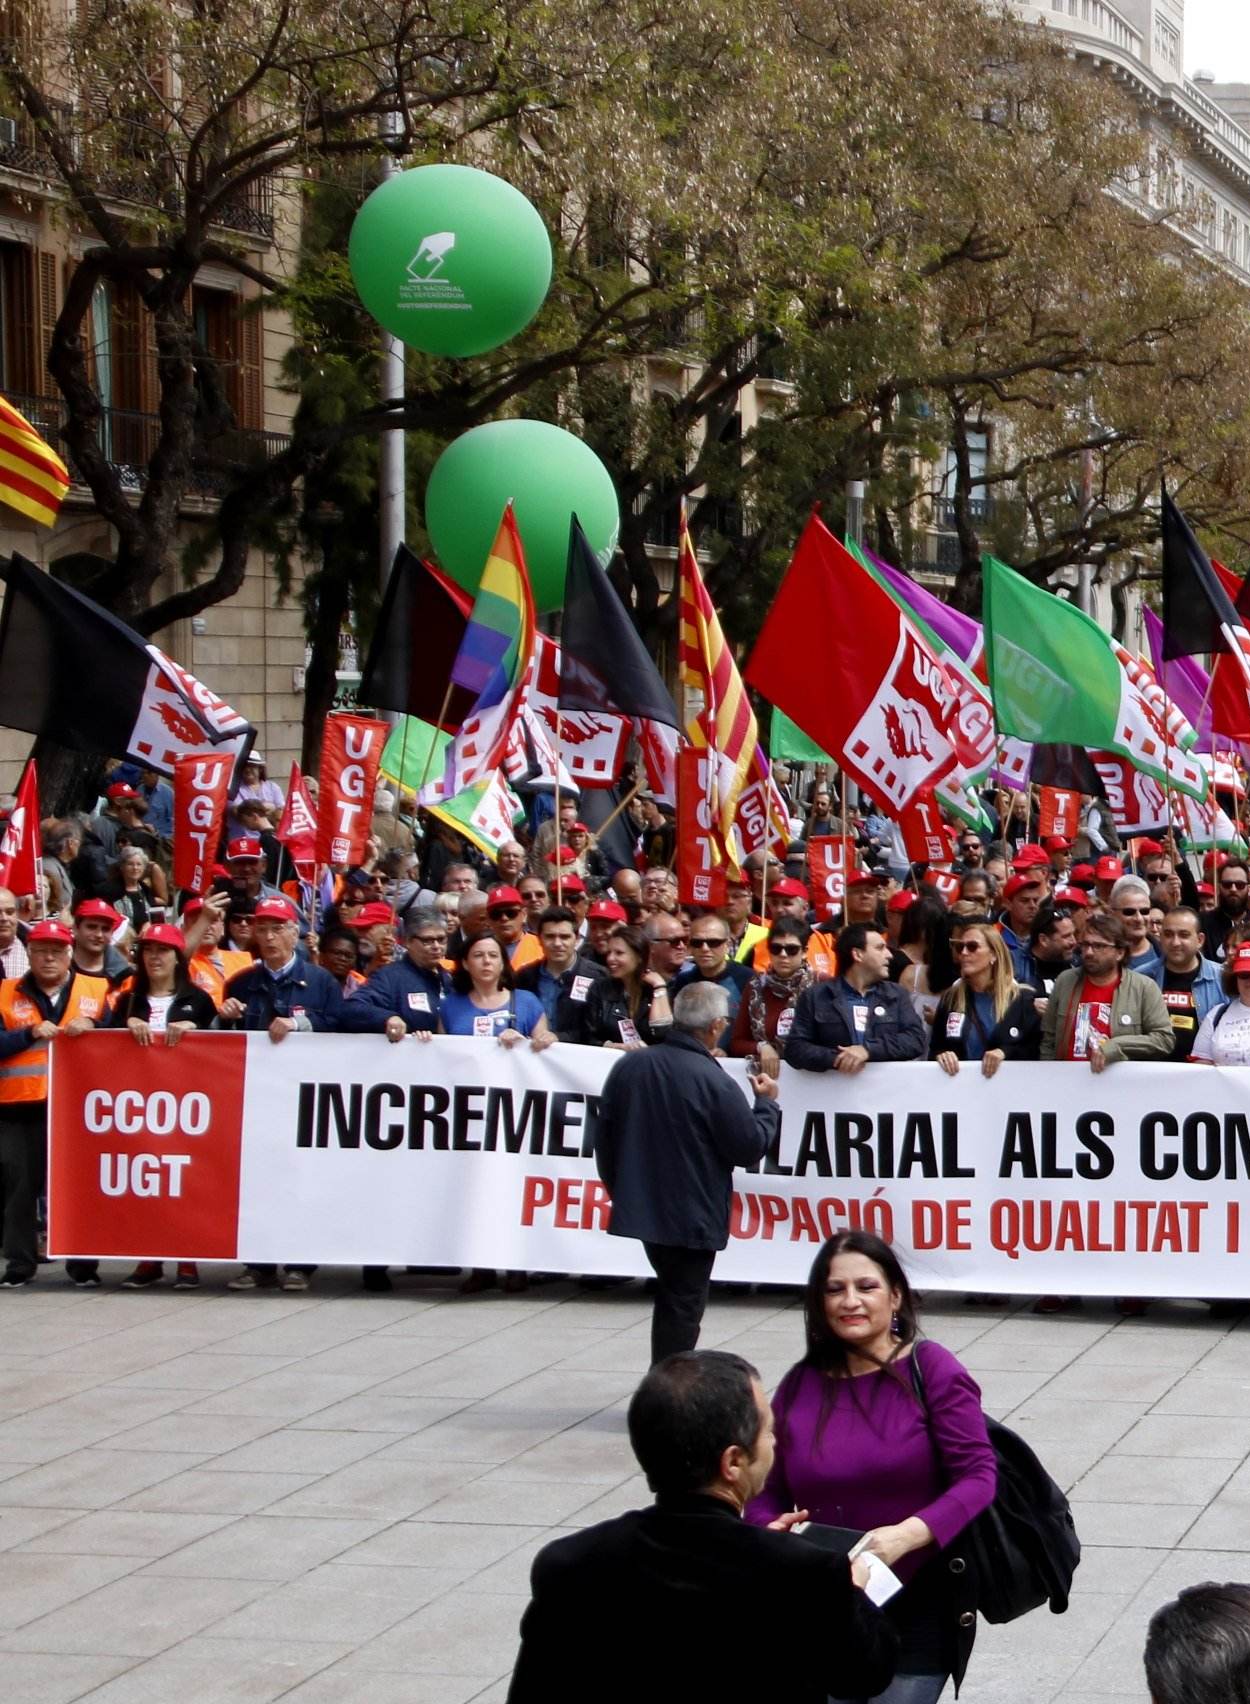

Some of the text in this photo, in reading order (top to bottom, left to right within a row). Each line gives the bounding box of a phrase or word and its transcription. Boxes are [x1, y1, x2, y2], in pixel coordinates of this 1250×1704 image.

[188, 761, 223, 862] UGT
[337, 726, 374, 833] UGT
[1162, 993, 1188, 1005] COO
[84, 1088, 212, 1136] CCOO
[297, 1081, 601, 1159] INCREME
[744, 1109, 975, 1179] LARIAL
[998, 1110, 1116, 1180] ALS
[99, 1151, 192, 1198] UGT
[520, 1175, 611, 1231] PER
[729, 1185, 894, 1246] UPACIÓ
[912, 1199, 972, 1250] DE
[989, 1198, 1209, 1260] QUALITAT
[1225, 1201, 1240, 1253] I
